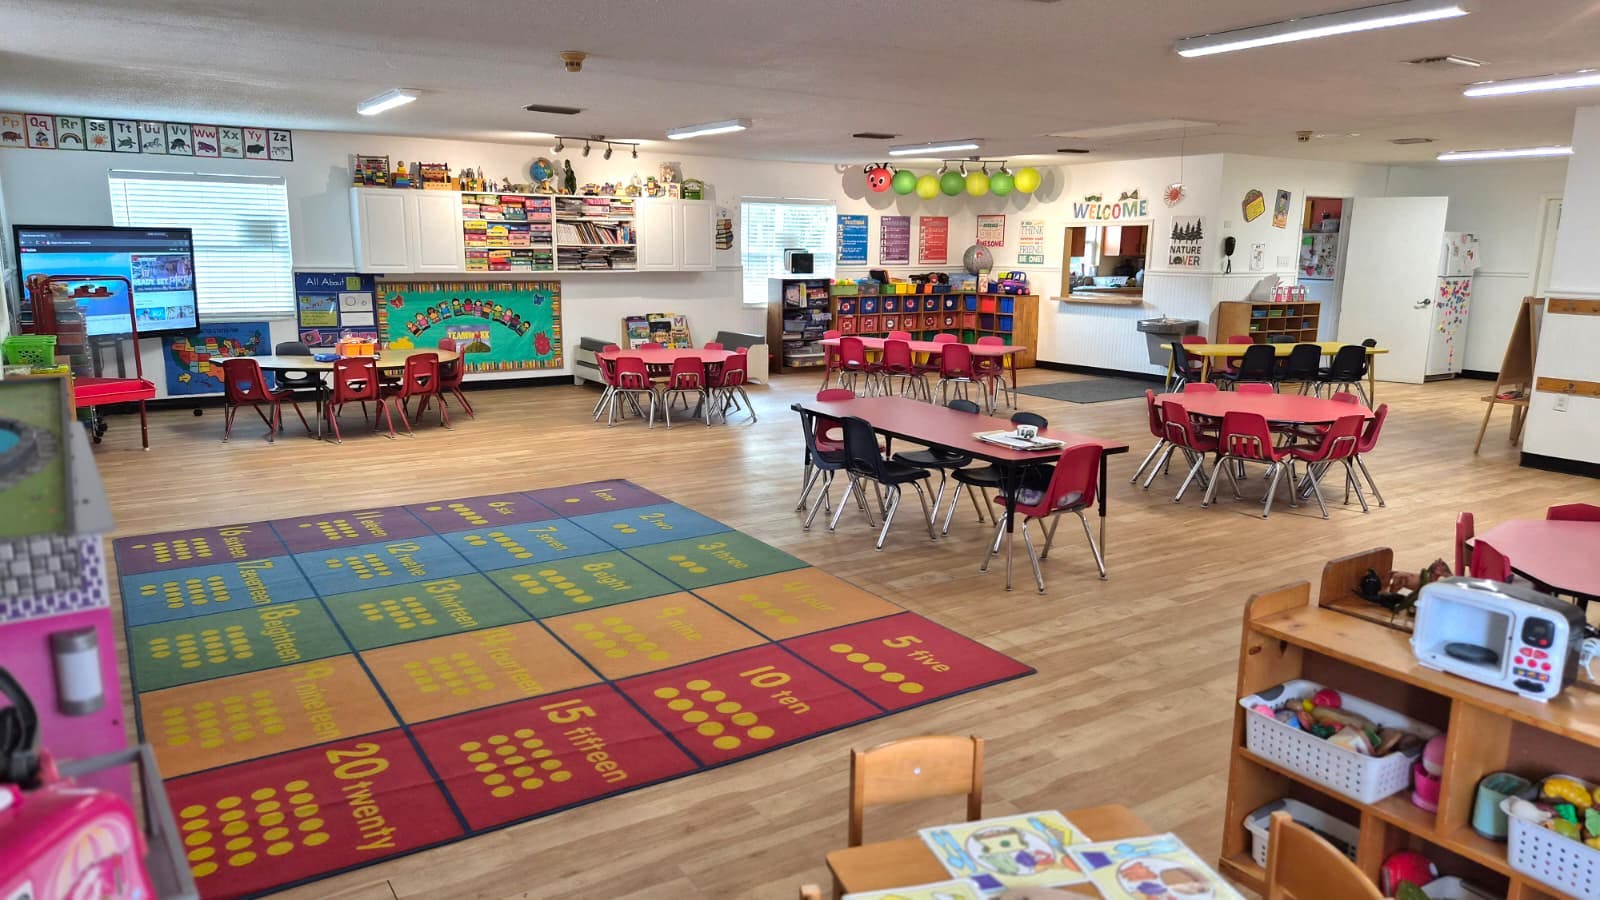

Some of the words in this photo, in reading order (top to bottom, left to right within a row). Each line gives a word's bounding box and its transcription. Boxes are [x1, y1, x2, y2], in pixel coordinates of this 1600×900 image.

[2, 116, 20, 128] Pp
[30, 117, 50, 132] Qq
[61, 118, 78, 129] Rr
[90, 122, 106, 132] Ss
[117, 123, 132, 133] Tt
[144, 124, 160, 134] Uu
[171, 126, 187, 136] Vv
[193, 129, 216, 139] Ww
[223, 130, 239, 140] Xx
[247, 131, 262, 142] Yy
[273, 132, 288, 142] Zz
[1073, 200, 1147, 220] WELCOME
[1169, 245, 1201, 255] NATURE
[305, 277, 319, 286] All
[321, 277, 345, 287] About
[638, 512, 667, 520] 2
[218, 525, 253, 536] 16
[360, 520, 388, 537] eleven
[223, 536, 249, 559] sixteen
[384, 542, 421, 554] 12
[536, 534, 568, 551] seven
[697, 542, 727, 550] 3
[236, 559, 274, 570] 17
[395, 553, 426, 576] twelve
[581, 561, 616, 571] 8
[711, 549, 749, 569] three
[240, 569, 272, 605] seventeen
[420, 579, 462, 594] 13
[592, 571, 633, 591] eight
[257, 603, 301, 620] 18
[433, 592, 479, 629] thirteen
[655, 606, 687, 619] 9
[260, 620, 301, 662] eighteen
[882, 635, 923, 648] 5
[906, 650, 950, 672] five
[483, 646, 545, 694] fourteen
[739, 665, 791, 688] 10
[770, 690, 810, 714] ten
[295, 683, 341, 740] nineteen
[539, 698, 597, 724] 15
[325, 742, 389, 780] 20
[563, 726, 628, 783] fifteen
[340, 780, 397, 850] twenty
